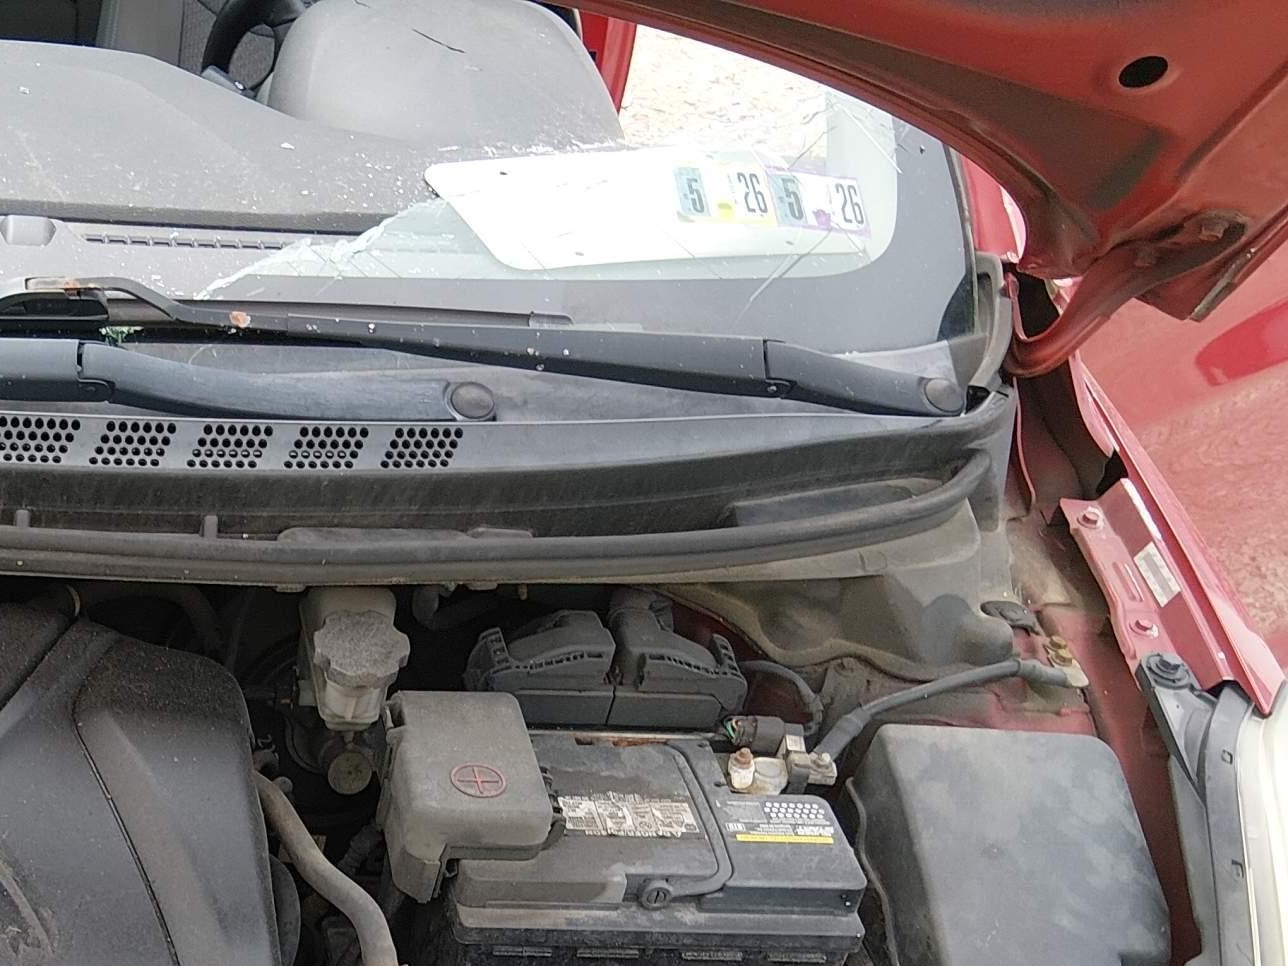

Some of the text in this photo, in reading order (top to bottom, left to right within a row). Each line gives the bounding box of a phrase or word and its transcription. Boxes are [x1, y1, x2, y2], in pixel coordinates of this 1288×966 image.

[686, 171, 769, 214] 5 26
[780, 176, 865, 225] 5 26
